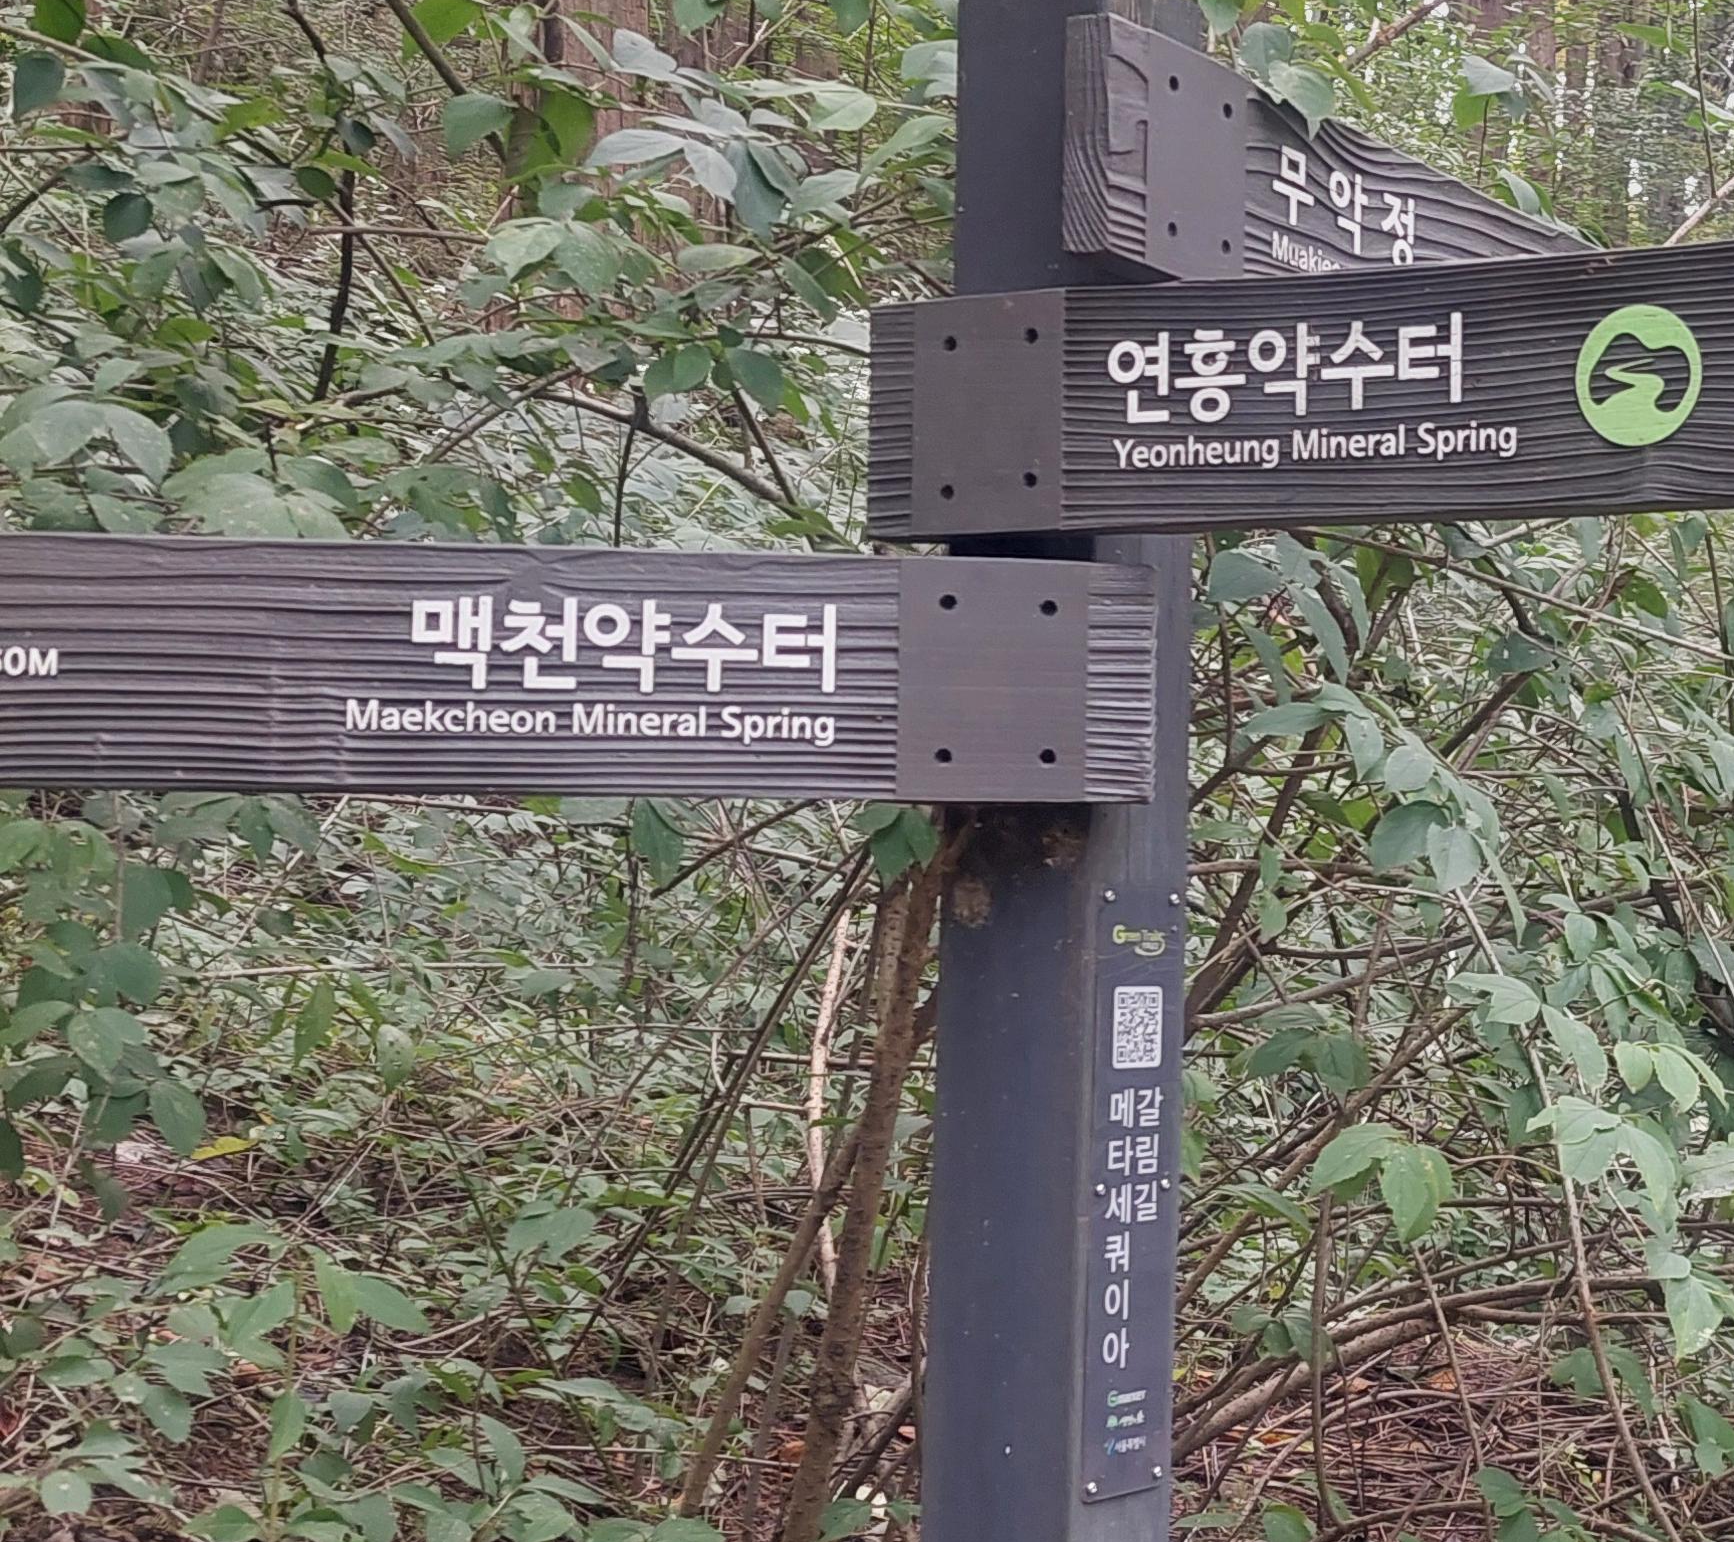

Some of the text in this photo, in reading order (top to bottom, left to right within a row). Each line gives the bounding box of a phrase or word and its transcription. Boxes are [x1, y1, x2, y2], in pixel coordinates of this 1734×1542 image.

[1272, 144, 1416, 266] 무악정
[1106, 311, 1463, 424] 연흥약수터
[1112, 419, 1519, 469] Yeonheung Mineral Spring
[0, 645, 59, 677] 0M
[410, 594, 837, 694] 맥천약수터
[344, 698, 837, 747] Maekcheon Mineral Spring
